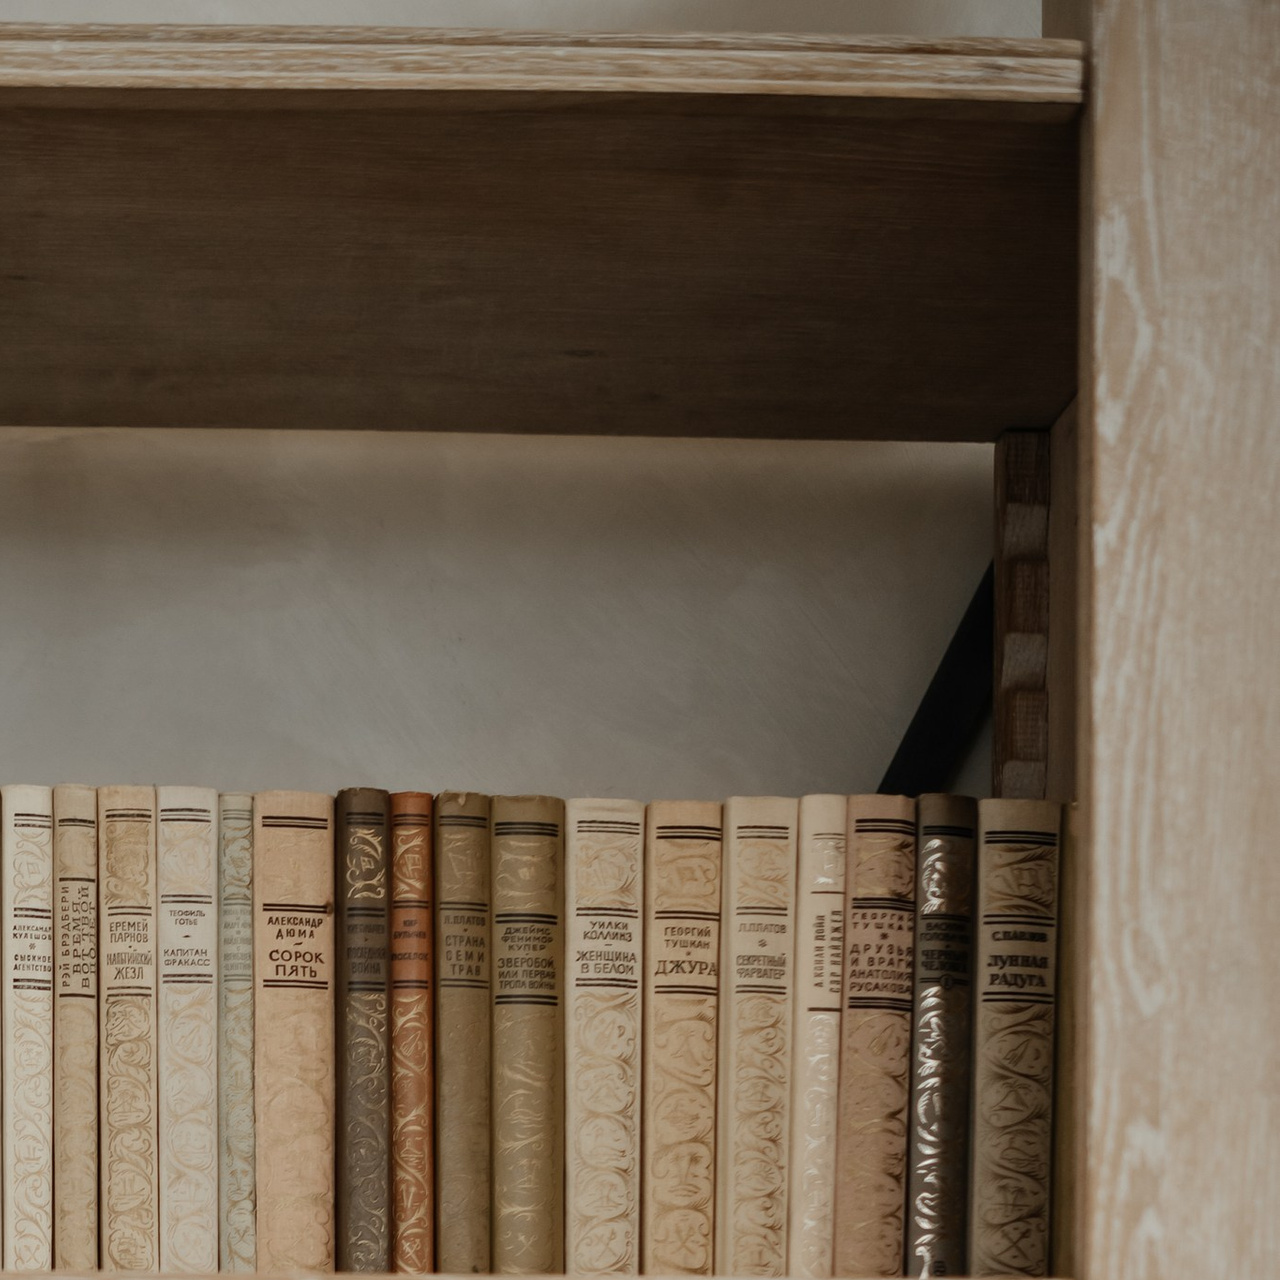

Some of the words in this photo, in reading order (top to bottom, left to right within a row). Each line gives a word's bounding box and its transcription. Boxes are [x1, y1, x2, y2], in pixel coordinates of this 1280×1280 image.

[78, 886, 90, 942] ТВОЙ
[169, 909, 206, 918] ТЕОФИЛЬ
[852, 912, 914, 922] ГЕОРГИЙ
[62, 886, 70, 956] БРЭДБЕРИ
[109, 920, 149, 932] ЕРЕМЕЙ
[174, 918, 198, 926] ГОТЬЕ
[267, 916, 323, 928] АЛЕКСАНДР
[590, 921, 628, 931] УИЛКИ
[852, 922, 914, 931] ТУШКАН
[12, 932, 52, 940] КУЛЕШОВ
[276, 928, 315, 940] ДЮМА
[504, 924, 551, 936] ДЖЕЙМС
[664, 926, 711, 937] ГЕОРГИЙ
[110, 932, 149, 944] ПАРНОВ
[445, 935, 485, 948] СТРАНА
[501, 934, 554, 944] ФЕНИМОР
[584, 931, 632, 942] КОЛЛИНЗ
[508, 943, 546, 952] КУПЕР
[664, 938, 710, 949] ТУШКАН
[164, 948, 208, 958] КАПИТАН
[850, 944, 913, 956] ДРУЗЬЯ
[14, 954, 52, 963] СЫСКНОЕ
[164, 958, 210, 967] ФРАКАСС
[269, 949, 324, 964] СОРОК
[446, 951, 484, 963] СЕМИ
[576, 951, 636, 963] ЖЕНЩИНА
[736, 953, 786, 968] СЕКРЕТНЫЙ
[850, 957, 859, 966] И
[868, 956, 913, 968] ВРАГИ
[987, 955, 1049, 970] ЛУННАЯ
[13, 964, 52, 972] АГЕНТСТВО
[82, 948, 90, 988] ВОТ
[114, 966, 144, 980] ЖЕЗЛ
[275, 964, 318, 978] ПЯТЬ
[351, 961, 381, 974] ВОЙНА
[450, 964, 480, 976] ТРАВ
[581, 964, 589, 974] В
[595, 962, 634, 975] БЕЛОЙ
[655, 960, 717, 976] ДЖУРА
[58, 963, 70, 987] РЭЙ
[498, 969, 519, 979] ИЛИ
[522, 969, 556, 980] ПЕРВАЯ
[737, 968, 785, 980] ФАРВАТЕР
[850, 969, 912, 982] АНАТОЛИЯ
[499, 980, 526, 990] ТРОПА
[829, 972, 841, 993] СЭР
[989, 973, 1046, 988] РАДУГА
[849, 982, 912, 994] РУСАКОВА
